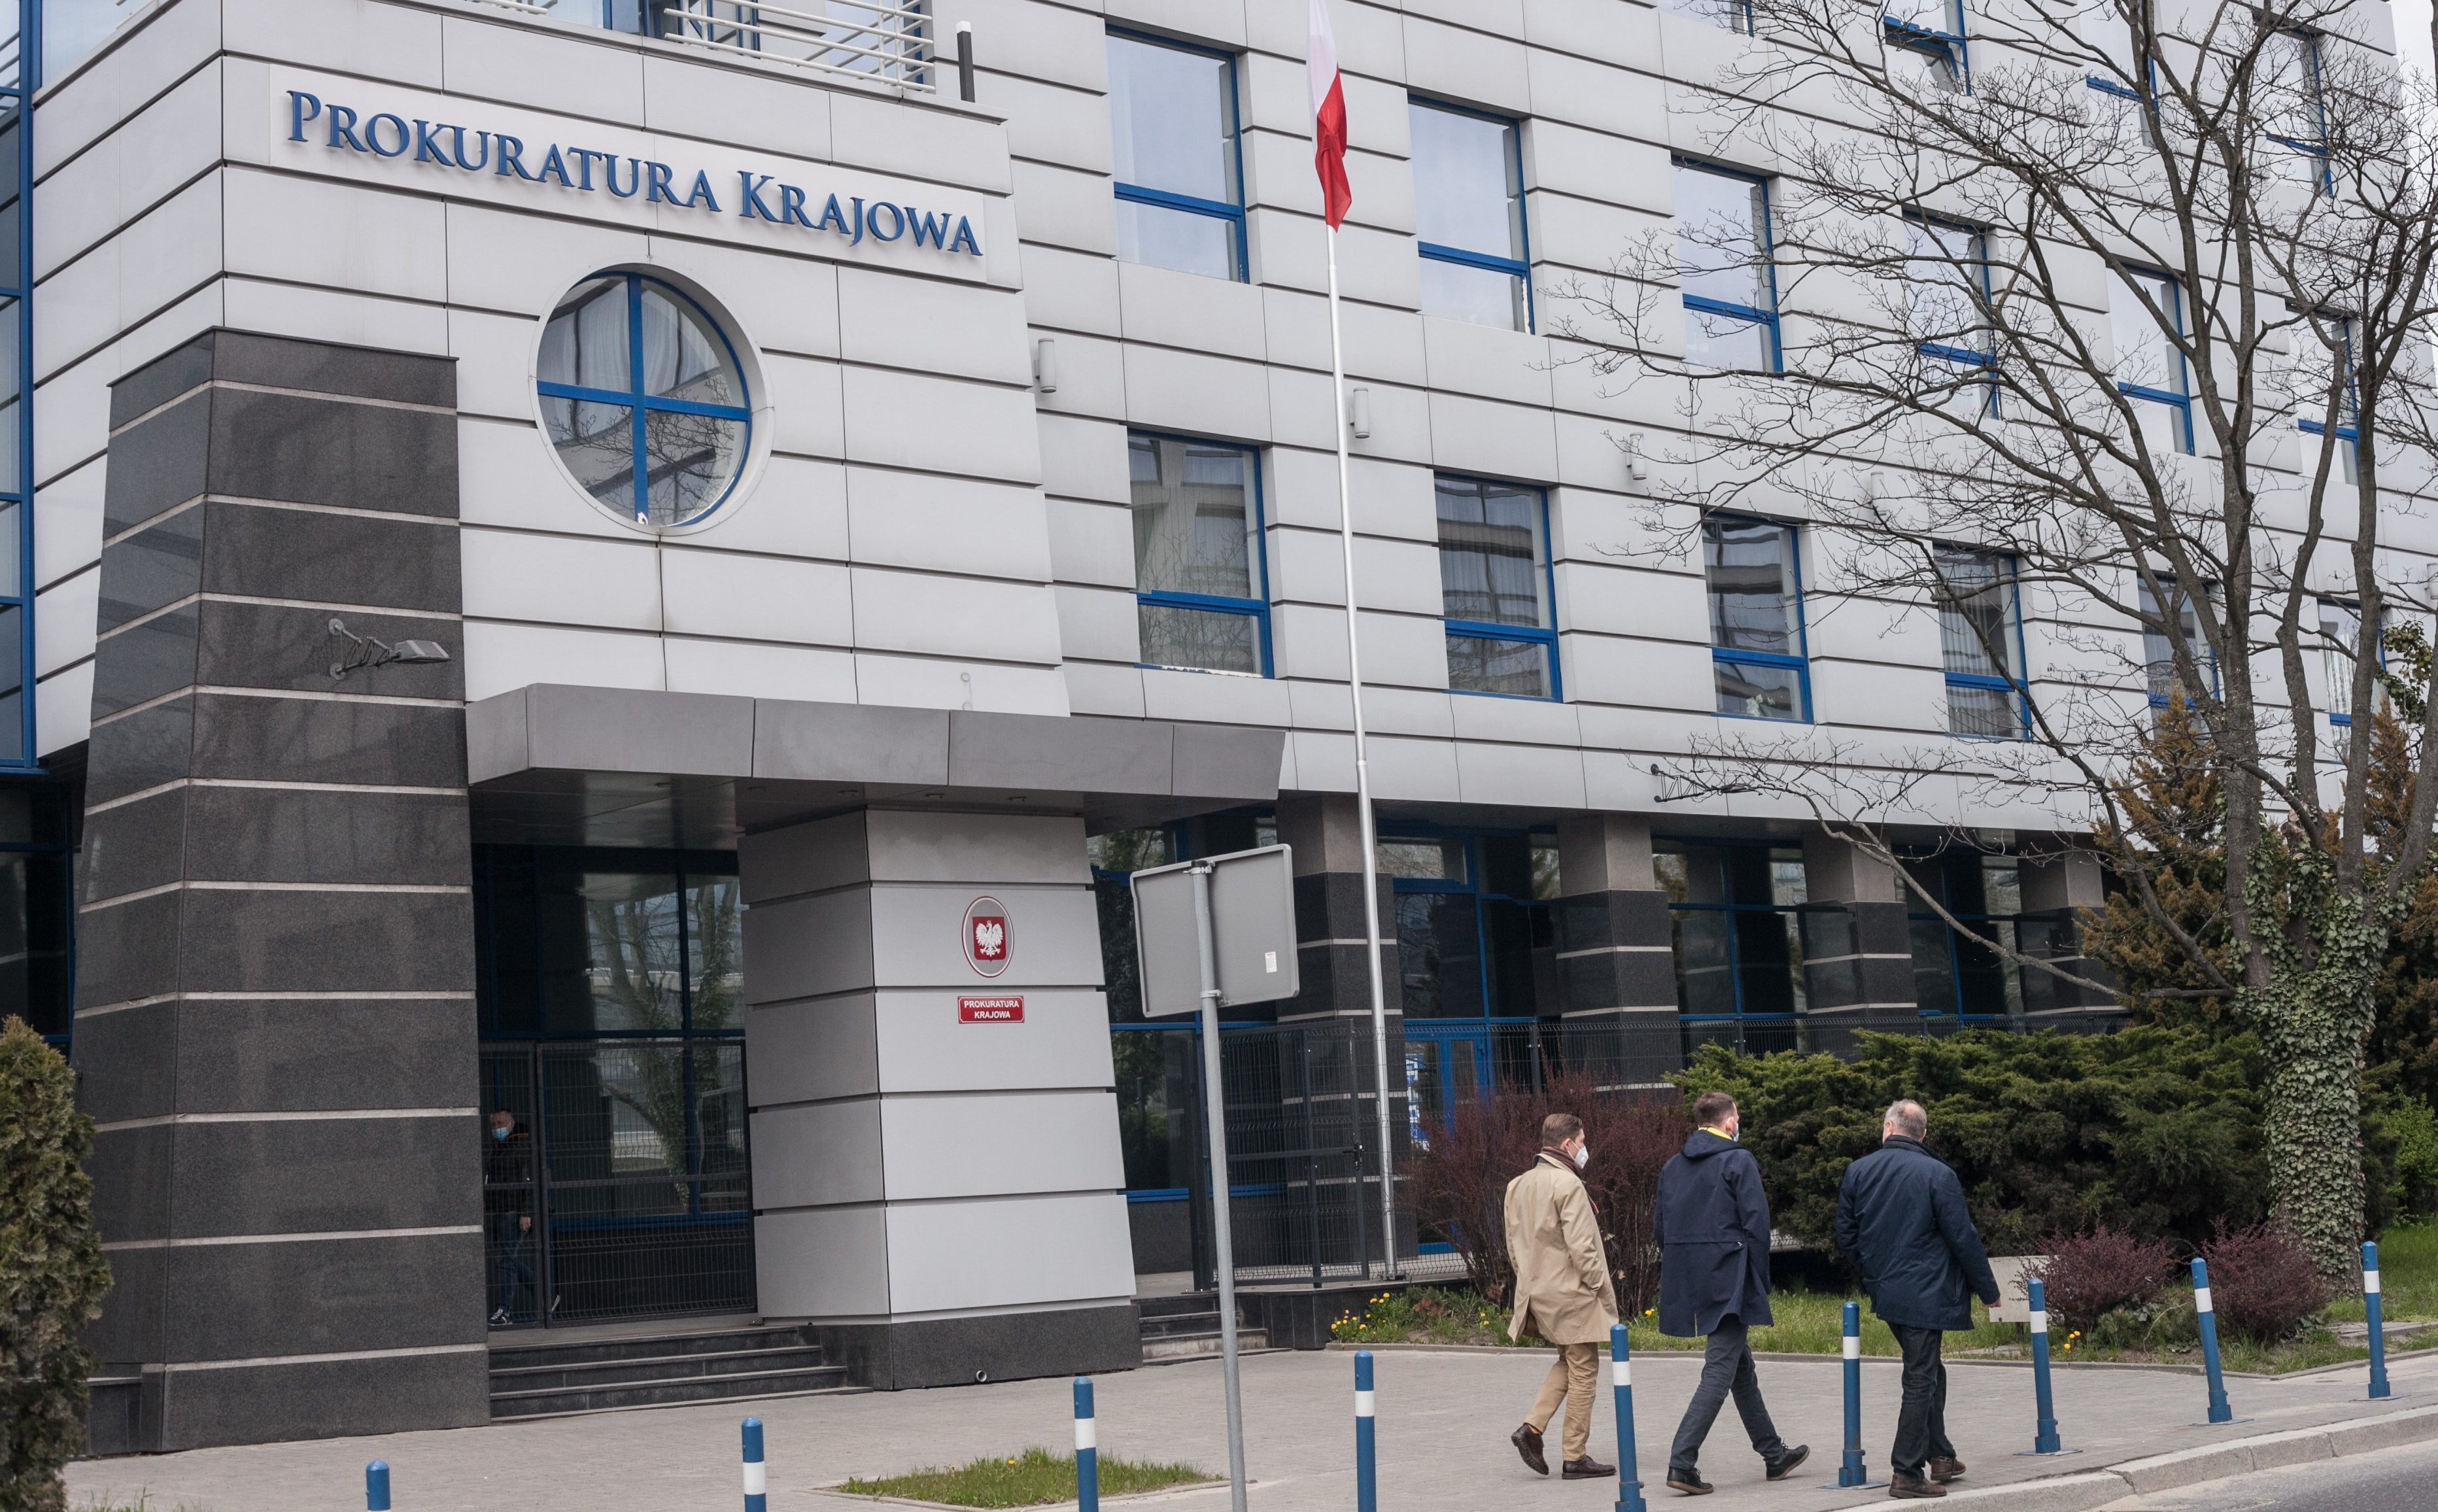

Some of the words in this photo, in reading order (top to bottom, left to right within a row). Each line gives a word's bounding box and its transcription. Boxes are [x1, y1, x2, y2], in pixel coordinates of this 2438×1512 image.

[286, 90, 722, 213] PROKURATURA
[737, 170, 982, 256] KRAJOWA
[963, 1000, 1020, 1008] PROKURATURA
[974, 1010, 1010, 1019] KRAJOWA
